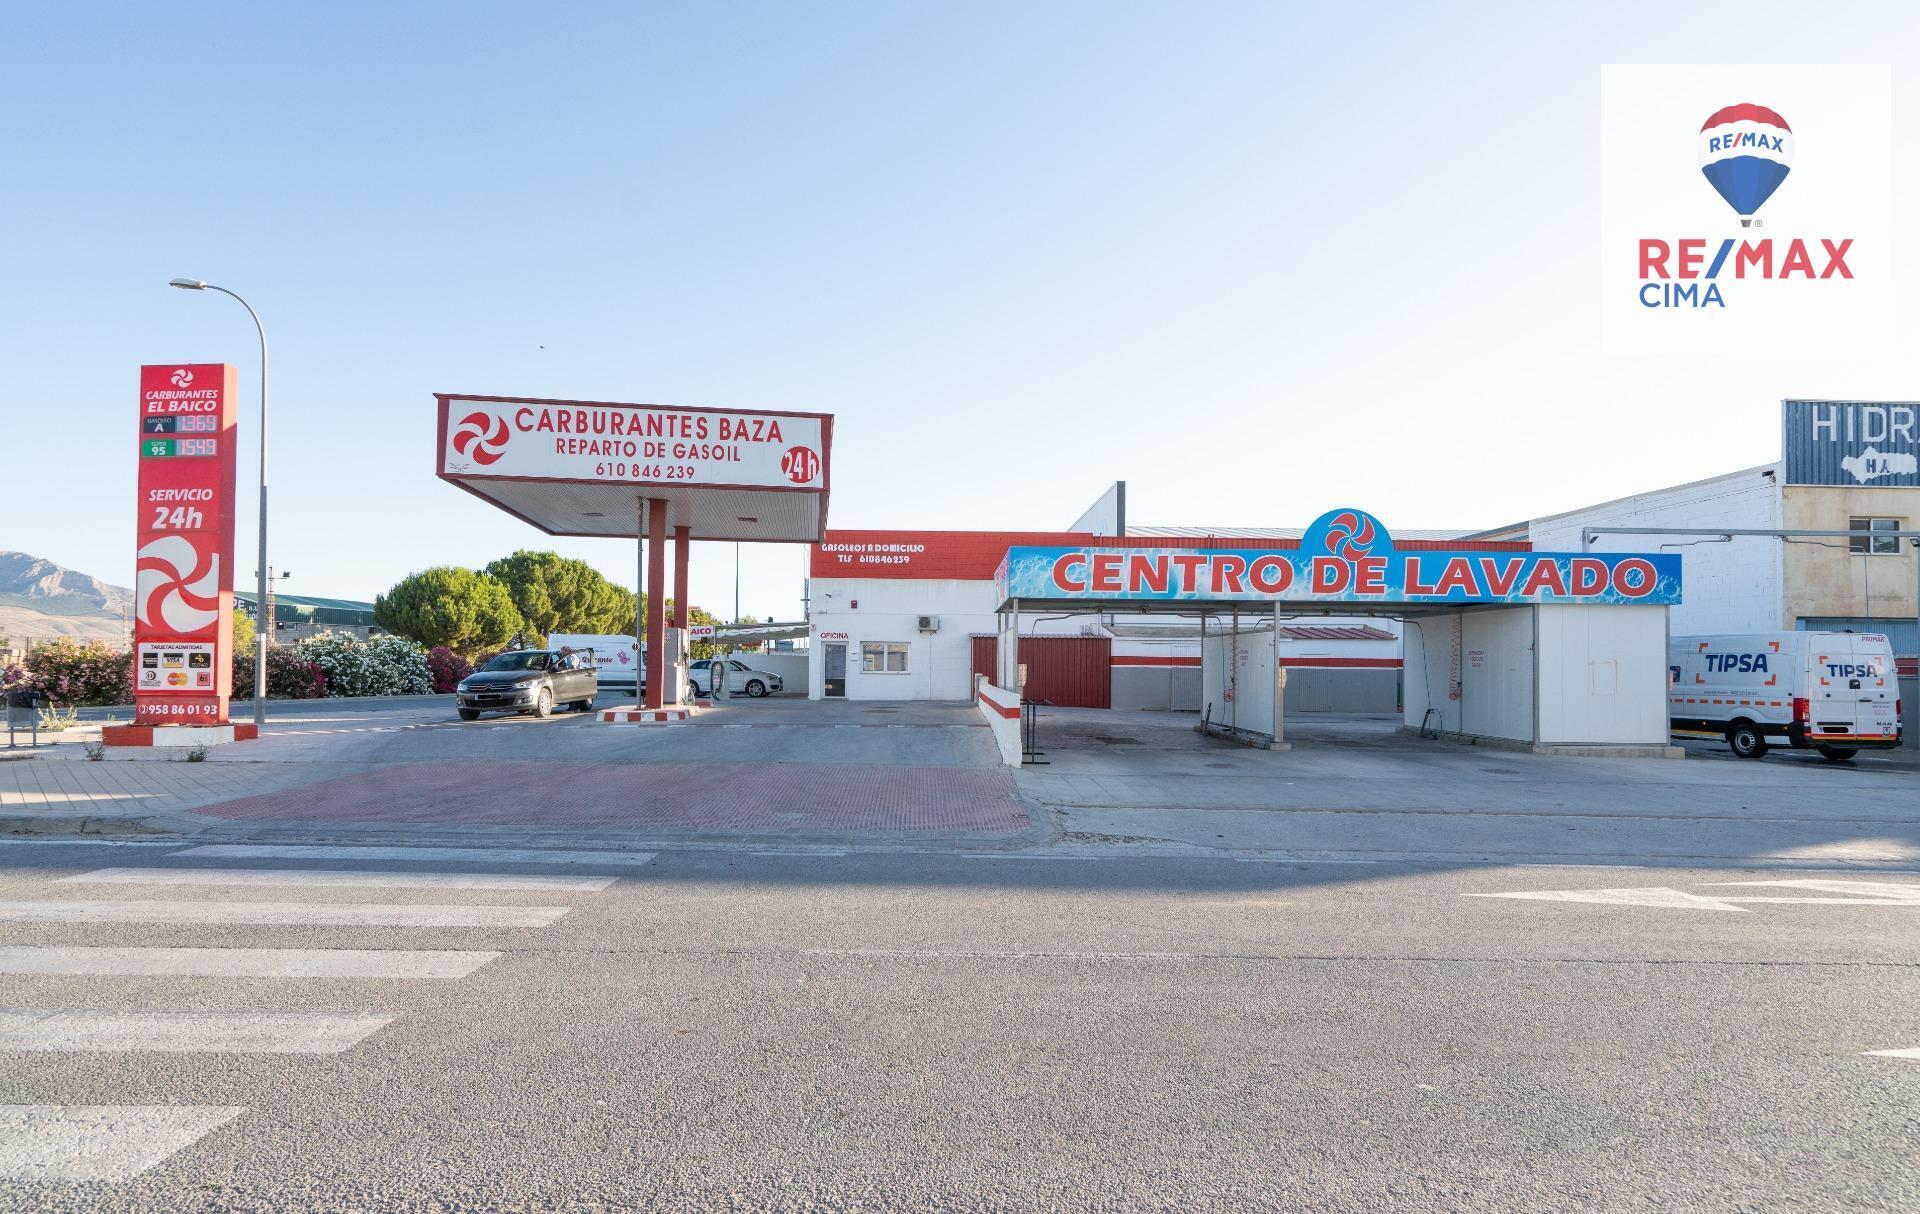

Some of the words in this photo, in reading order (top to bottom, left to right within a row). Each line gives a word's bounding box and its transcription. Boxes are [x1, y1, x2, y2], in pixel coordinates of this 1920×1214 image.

[146, 390, 218, 400] CARBURANTES
[147, 401, 165, 412] EL
[168, 400, 216, 412] BAICO
[154, 424, 164, 432] A
[515, 408, 708, 440] CARBURANTES
[719, 418, 783, 443] BAZA
[1812, 405, 1920, 443] HIDR
[151, 446, 166, 456] 95
[556, 438, 637, 457] REPARTO
[644, 442, 666, 458] DE
[673, 443, 741, 462] GASOIL
[596, 462, 625, 477] 610
[632, 464, 661, 478] 846
[666, 466, 695, 479] 239
[148, 488, 213, 501] SERVICIO
[152, 506, 202, 529] 24h
[821, 543, 866, 552] GASOLEOS
[867, 544, 873, 552] A
[875, 544, 925, 553] DOMICILIO
[859, 555, 910, 564] 610846239
[1051, 553, 1295, 595] CENTRO
[1311, 555, 1388, 596] DE
[1404, 557, 1658, 598] LAVADO
[1705, 654, 1768, 673] TIPSA
[1826, 664, 1878, 678] TIPSA
[148, 705, 168, 714] 958
[171, 705, 185, 714] 86
[187, 705, 200, 714] 01
[204, 705, 217, 714] 93
